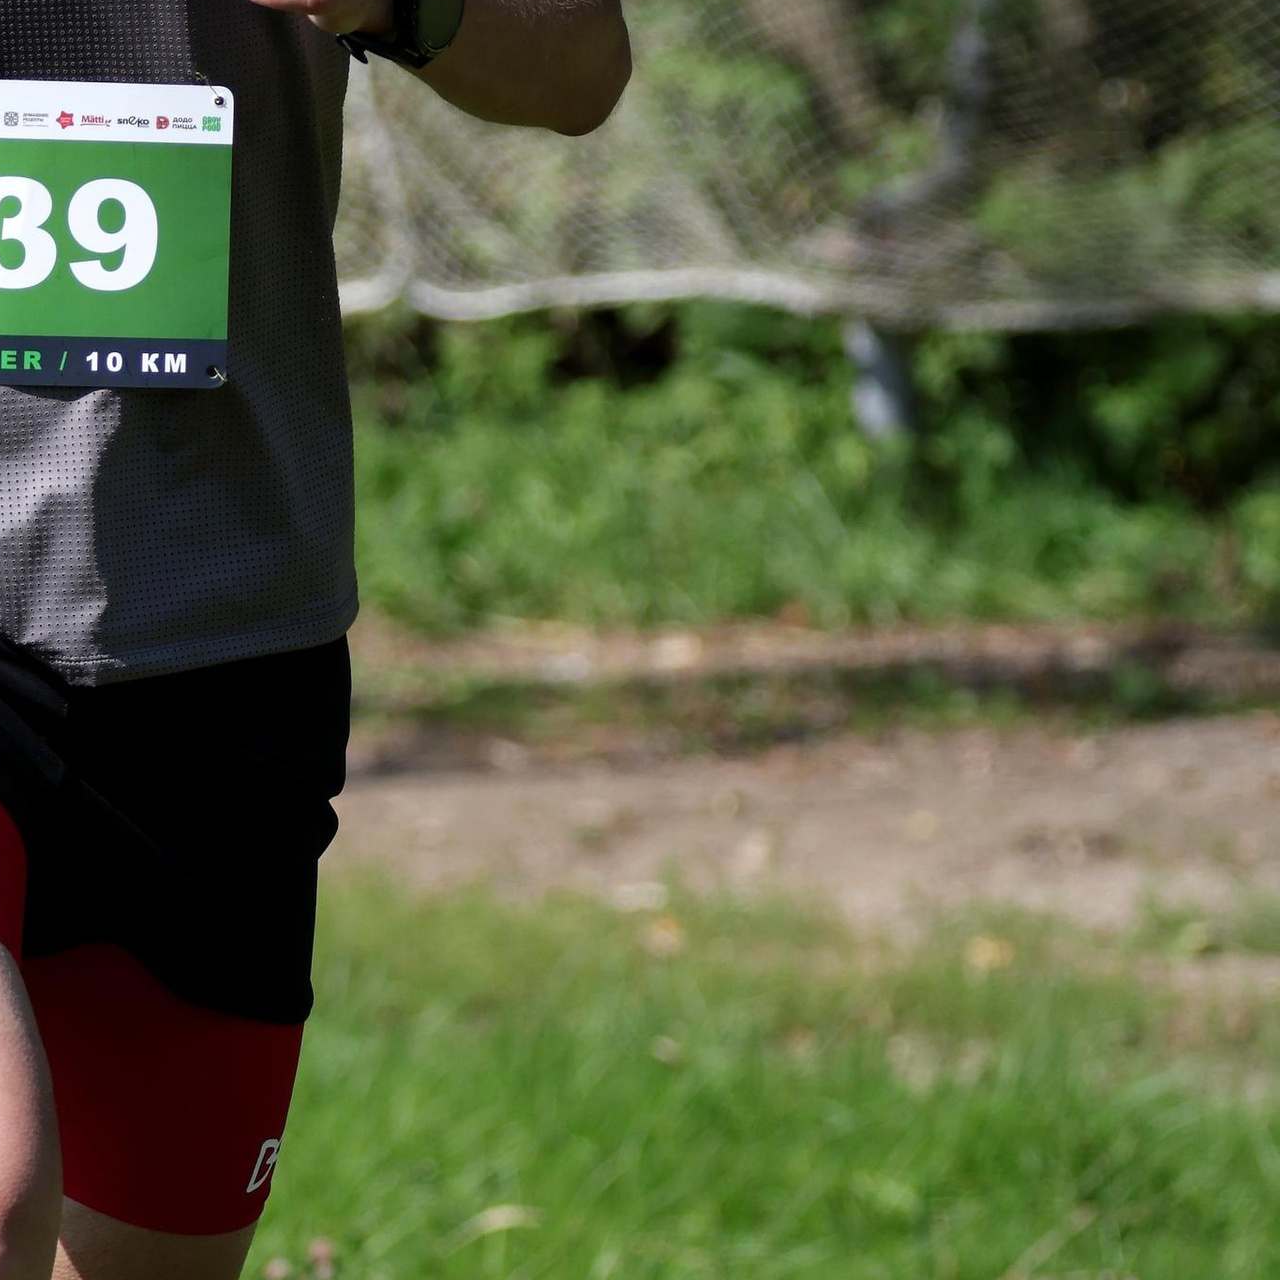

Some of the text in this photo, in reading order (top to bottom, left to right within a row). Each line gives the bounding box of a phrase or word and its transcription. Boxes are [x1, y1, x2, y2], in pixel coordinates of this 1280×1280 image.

[81, 115, 105, 123] Mätti
[86, 351, 123, 372] 10
[141, 352, 187, 373] KM
